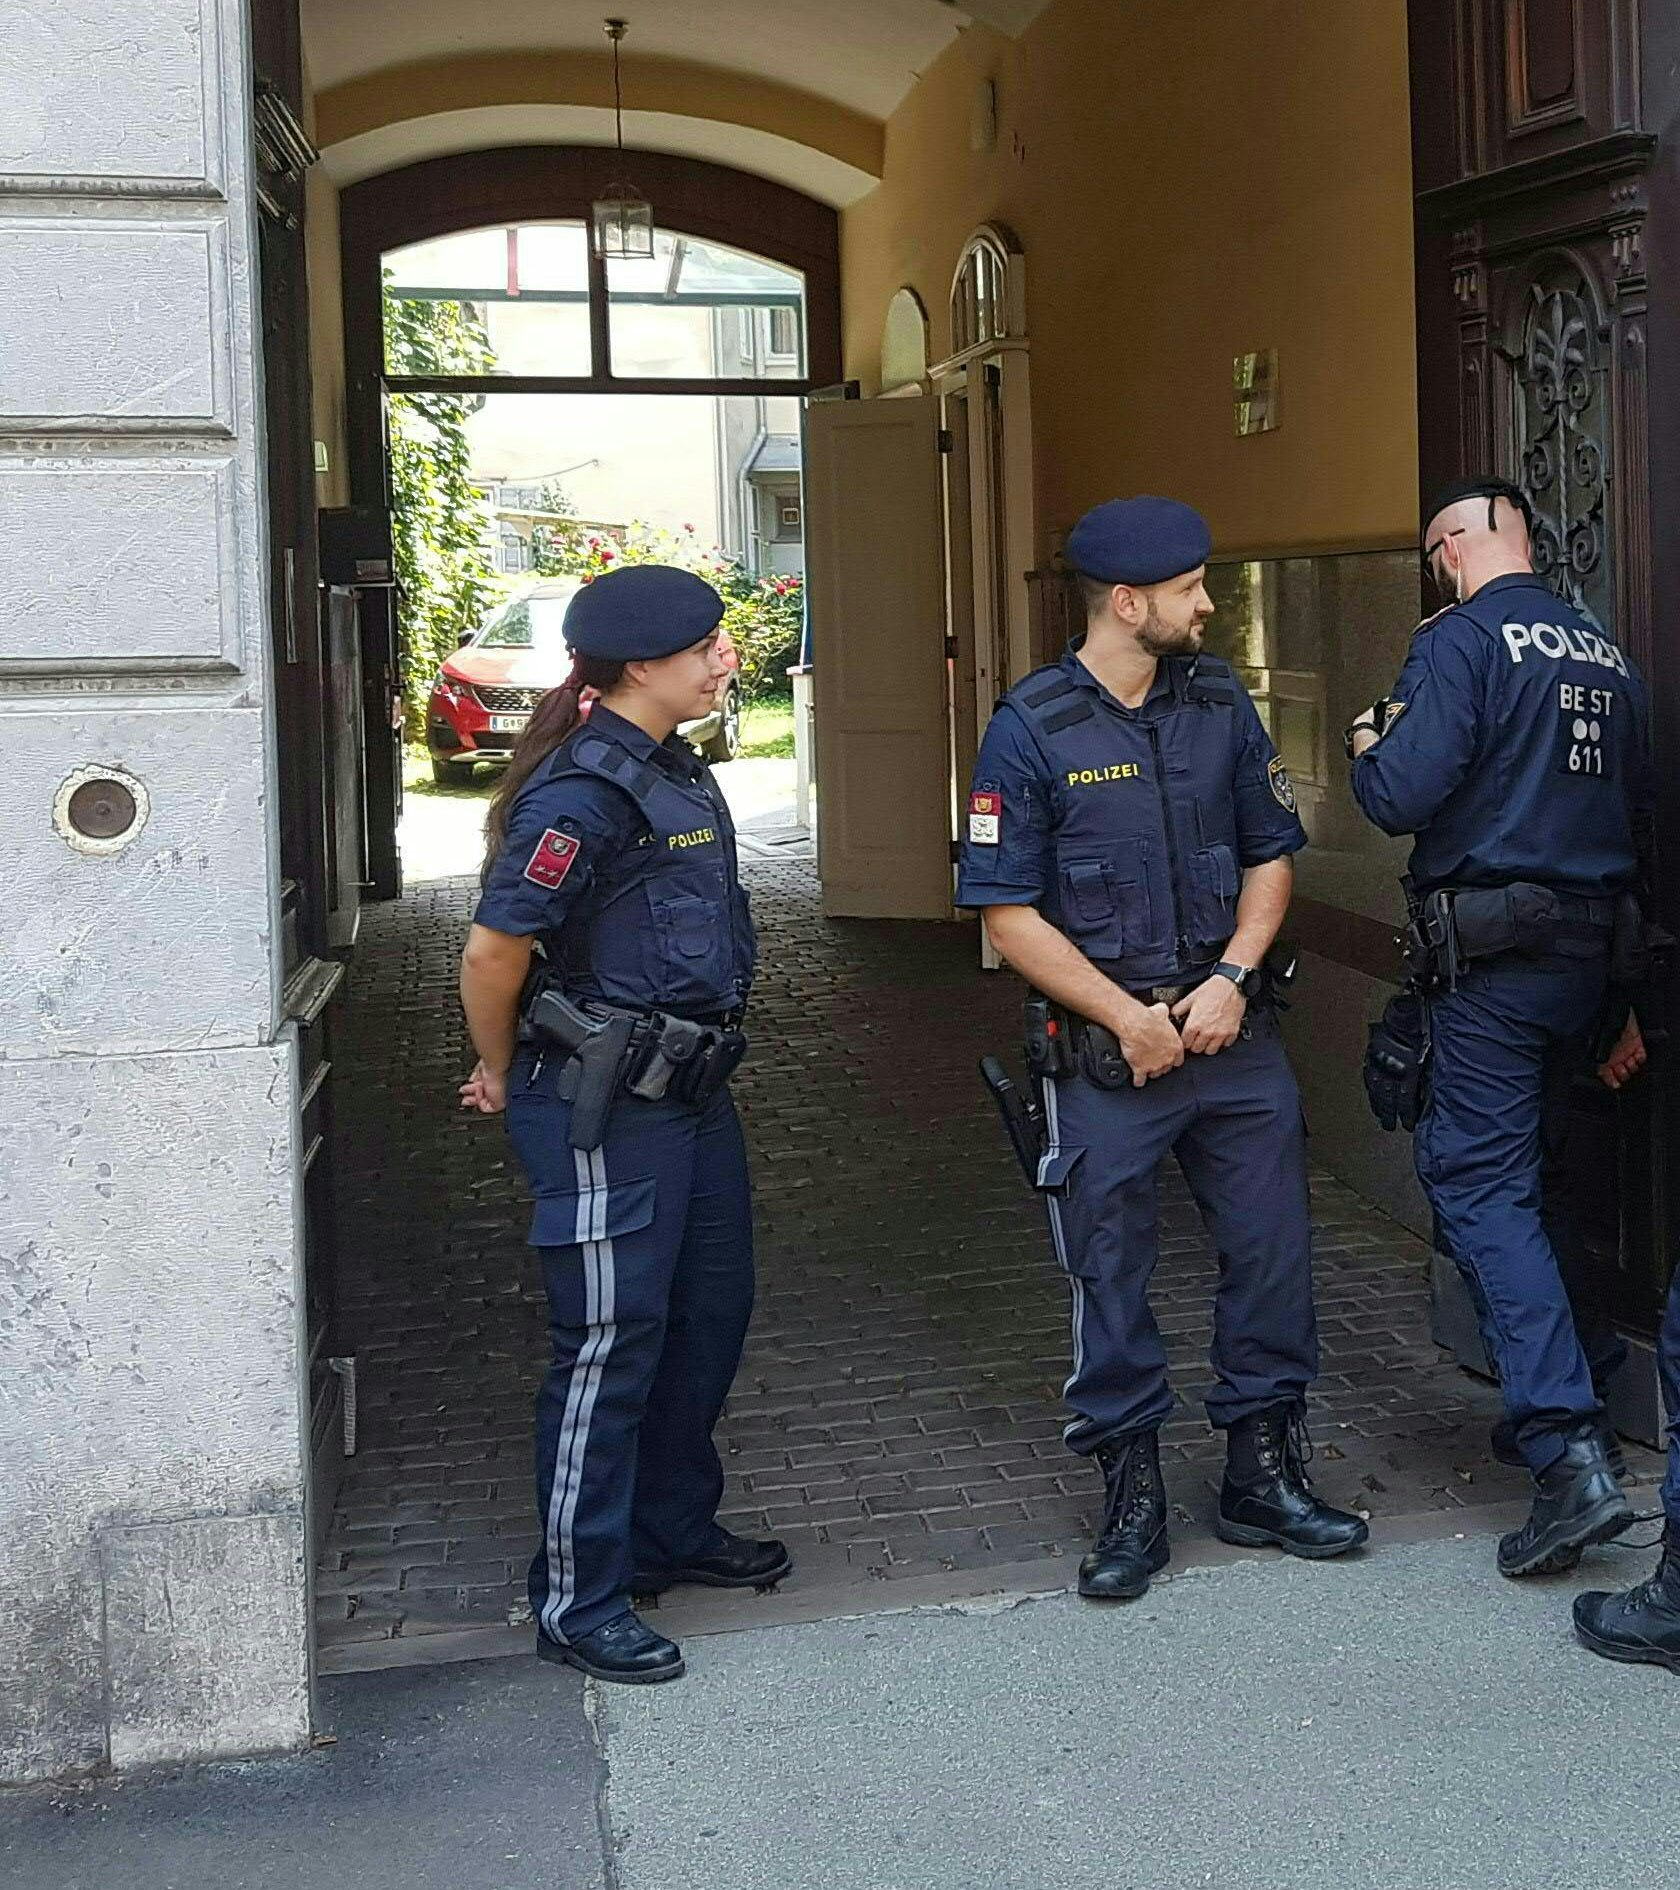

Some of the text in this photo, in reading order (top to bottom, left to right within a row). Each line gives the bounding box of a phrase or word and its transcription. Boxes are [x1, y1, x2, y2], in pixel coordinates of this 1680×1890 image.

[1568, 744, 1602, 774] 611
[1067, 763, 1139, 787] POLIZEI
[668, 827, 715, 851] POLIZEI
